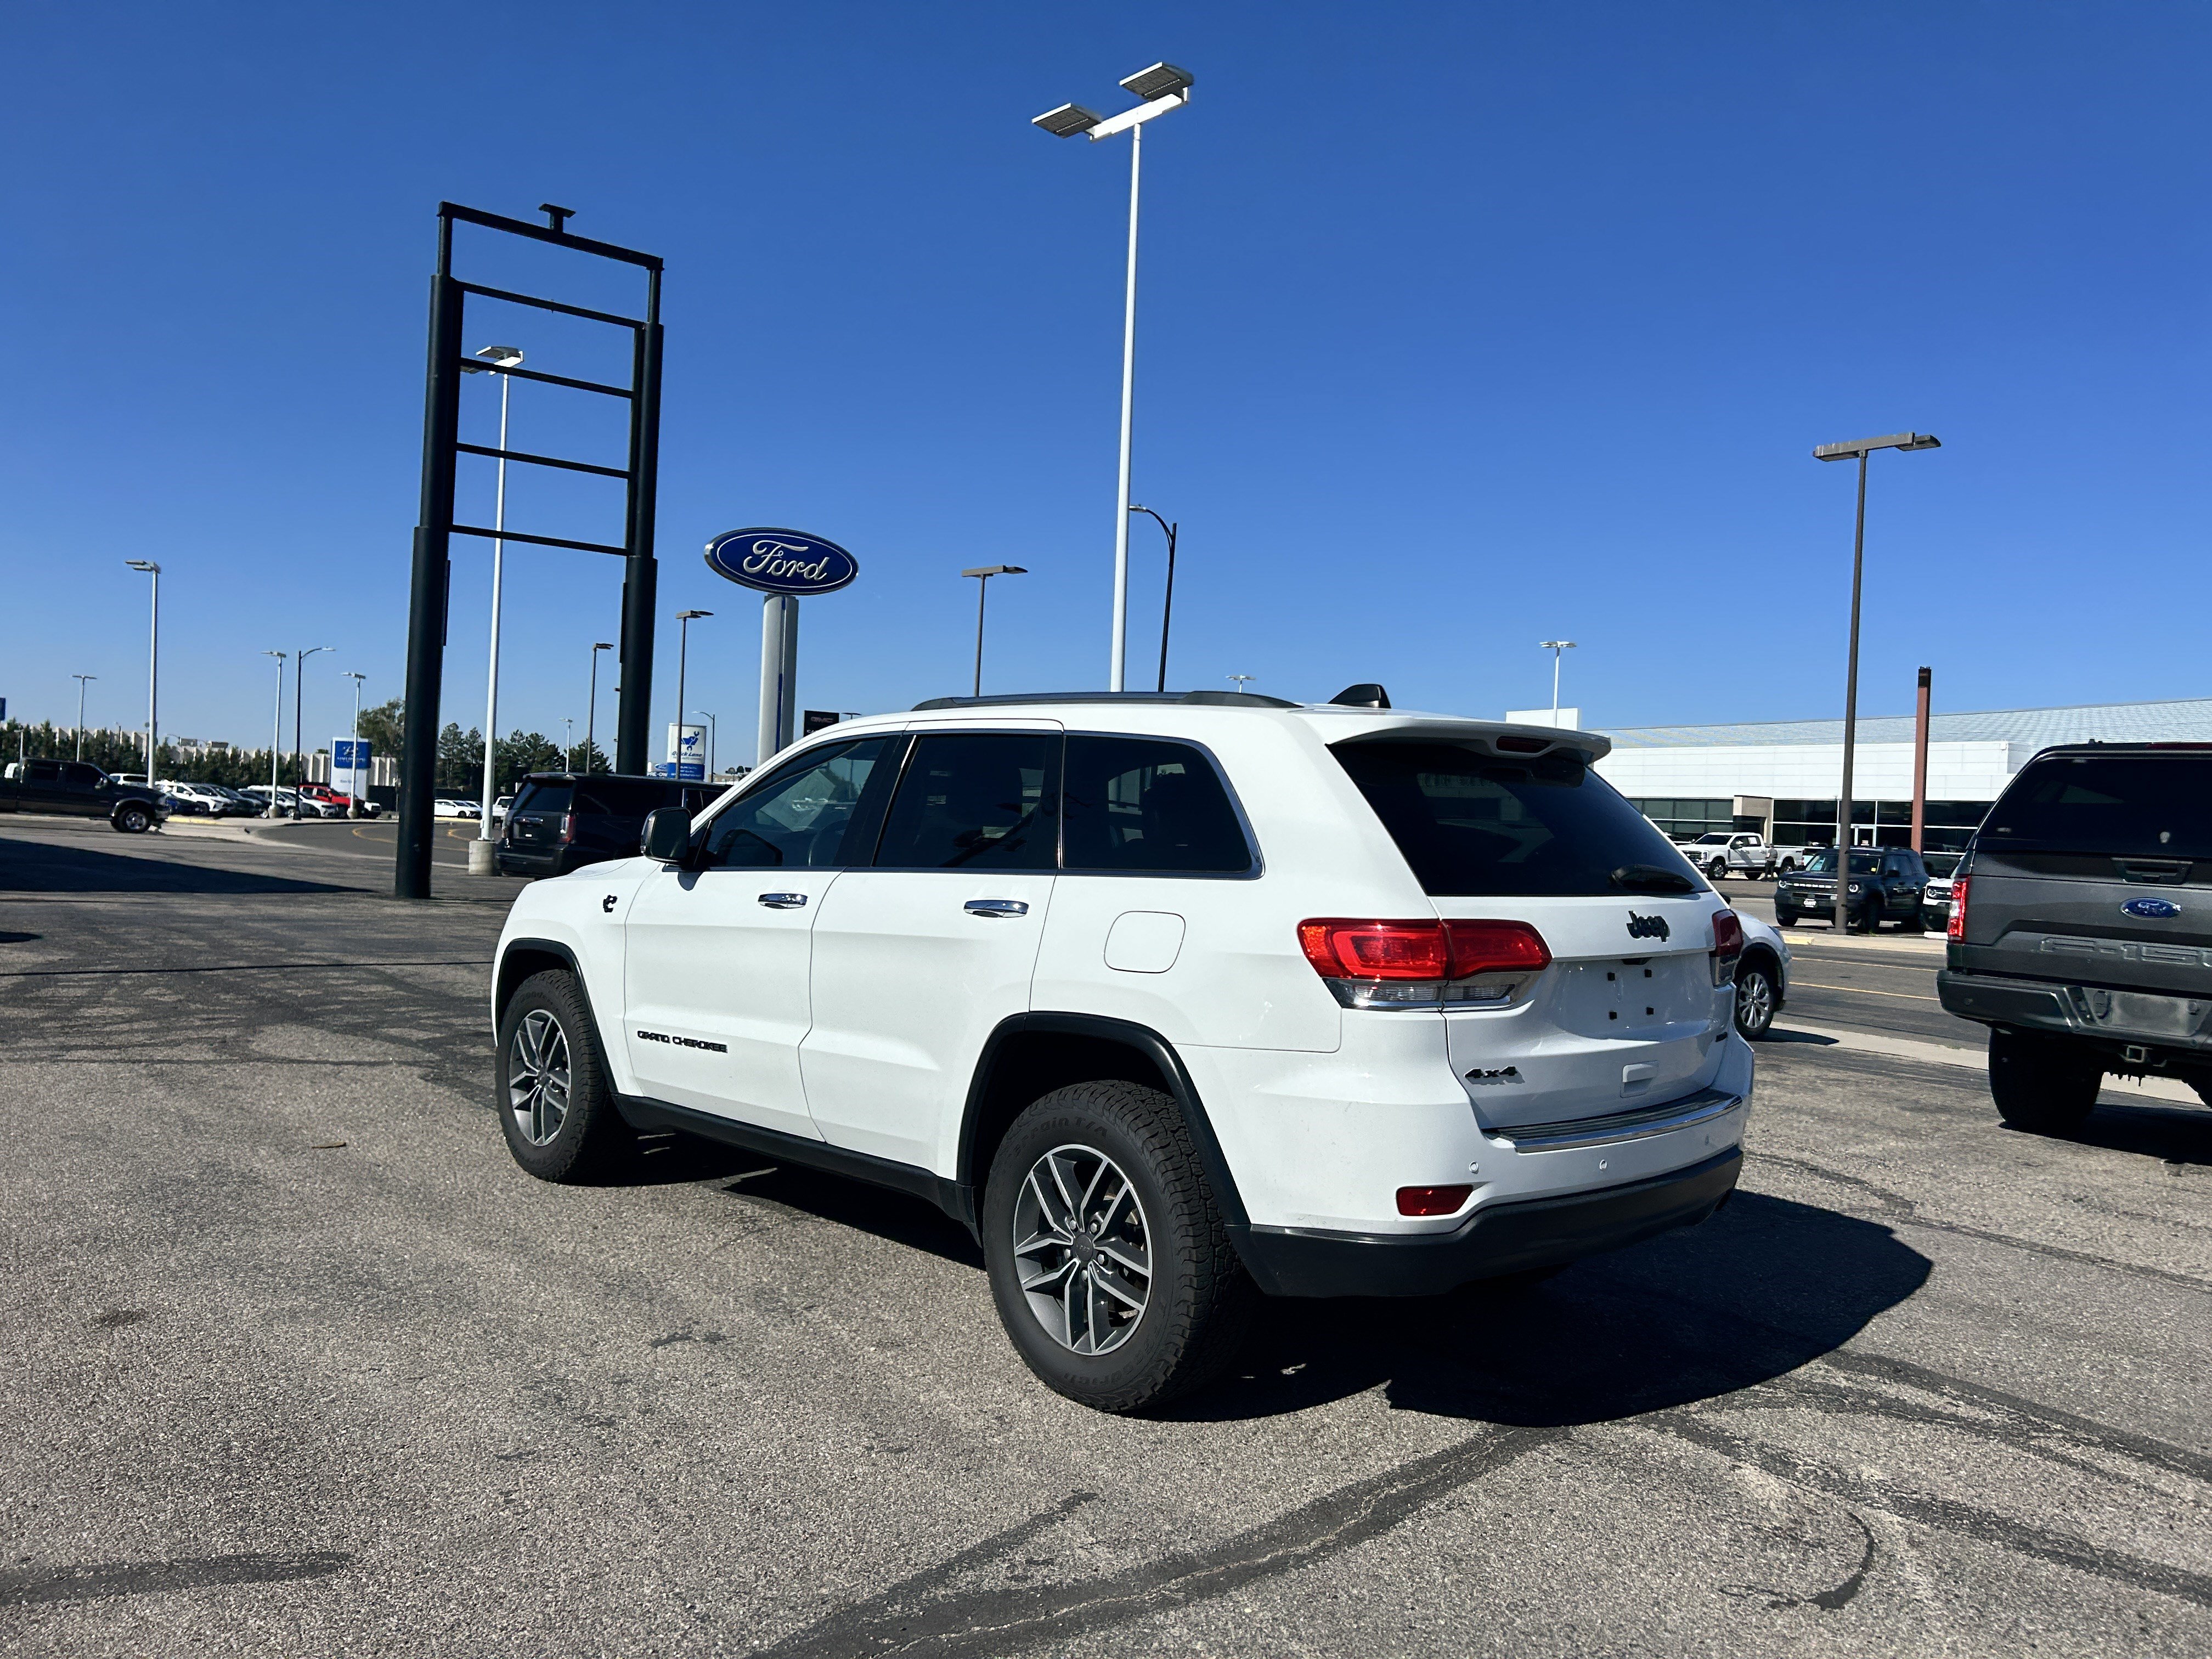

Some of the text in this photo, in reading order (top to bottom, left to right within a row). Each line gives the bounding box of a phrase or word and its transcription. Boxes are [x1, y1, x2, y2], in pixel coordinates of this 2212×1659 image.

[743, 540, 830, 580] Ford
[1626, 911, 1671, 943] Jeep
[2039, 936, 2212, 968] F-15
[637, 1030, 728, 1053] GRAND CHEROKEE
